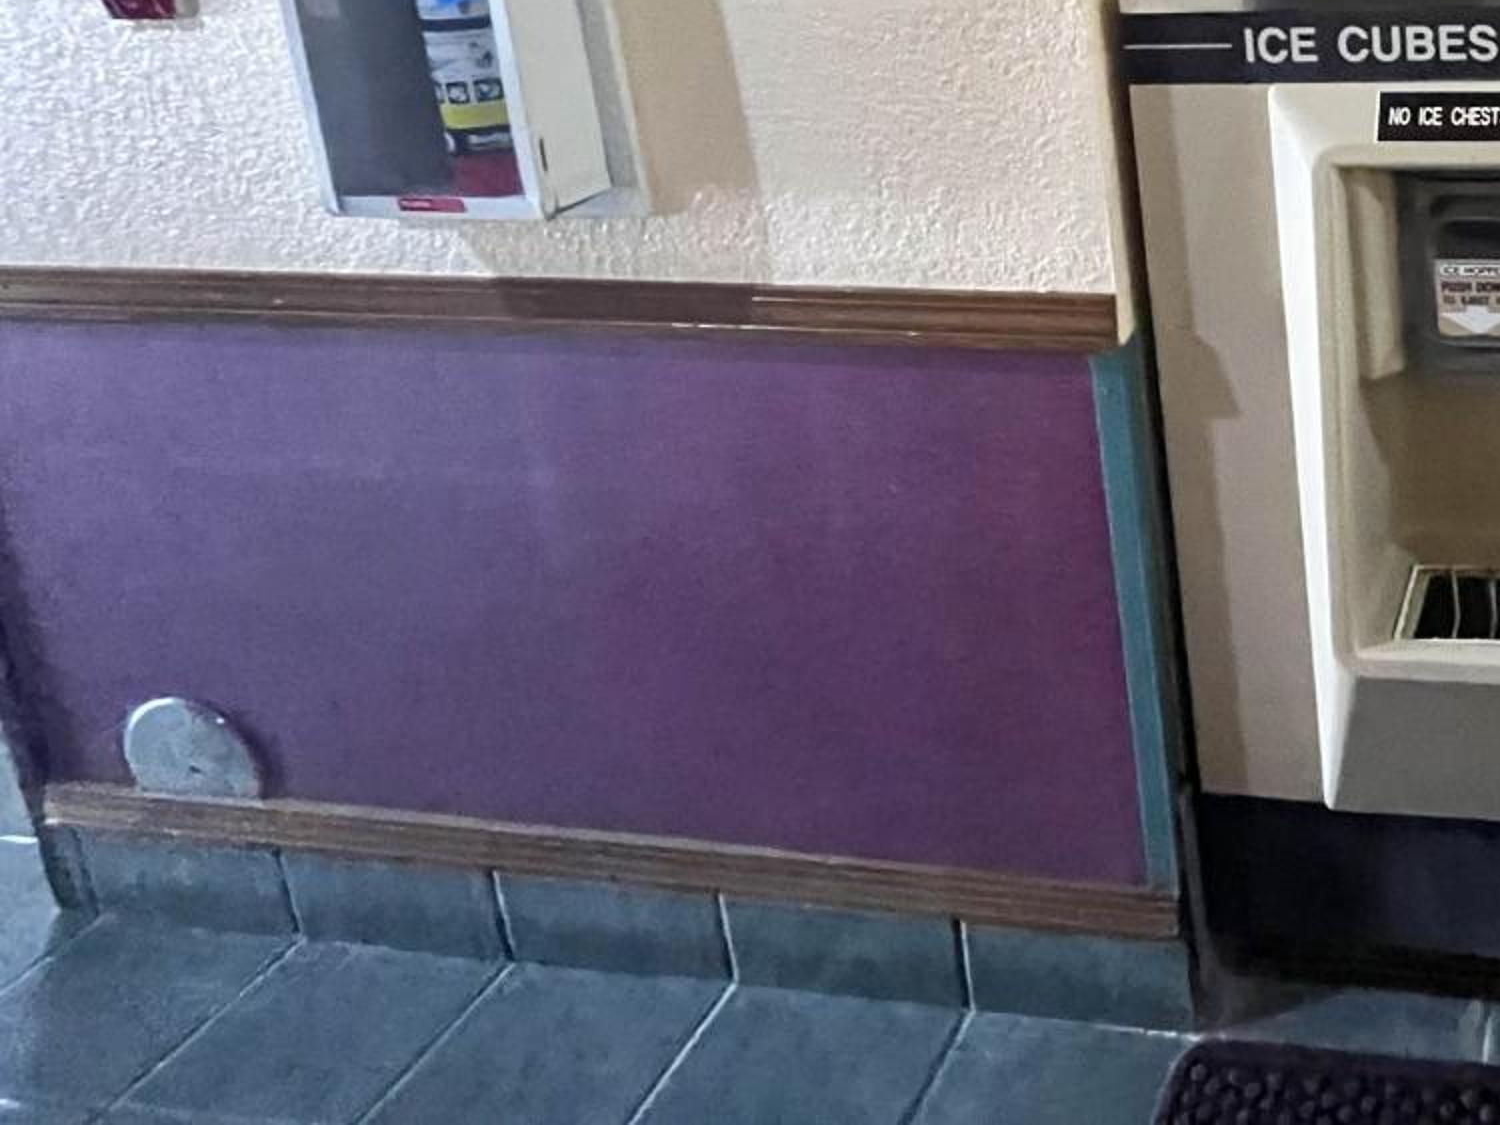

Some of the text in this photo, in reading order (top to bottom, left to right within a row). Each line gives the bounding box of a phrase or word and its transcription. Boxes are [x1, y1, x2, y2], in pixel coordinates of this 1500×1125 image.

[1244, 25, 1499, 63] ICE CUBES
[1388, 106, 1411, 126] NO
[1418, 106, 1443, 126] ICE
